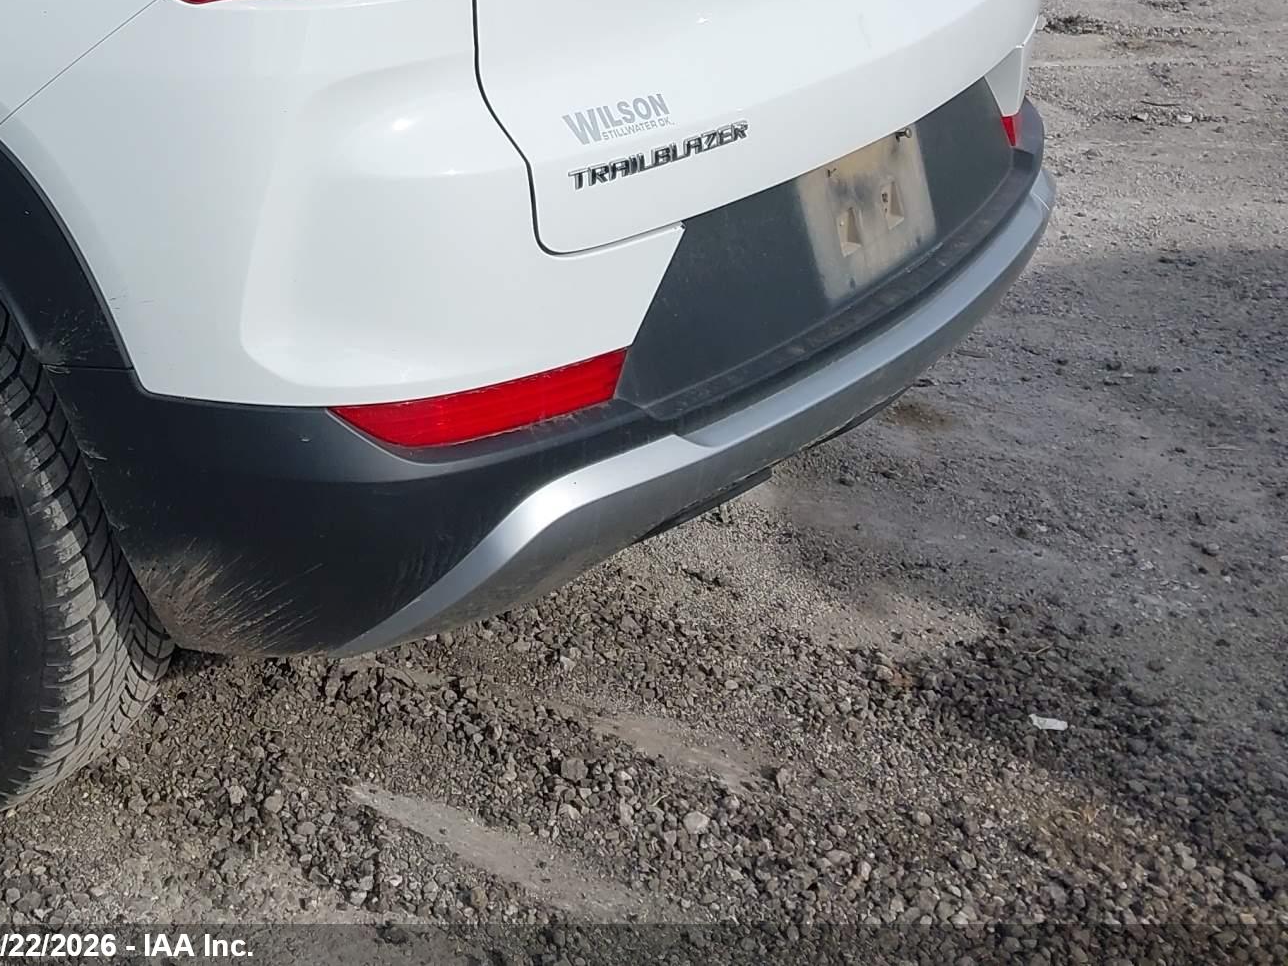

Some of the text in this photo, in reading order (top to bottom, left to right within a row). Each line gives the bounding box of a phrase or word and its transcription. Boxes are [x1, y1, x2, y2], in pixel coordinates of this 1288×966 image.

[562, 93, 670, 145] WILSON
[601, 120, 658, 141] STILLWATER
[567, 120, 749, 190] TRAILBLAZER
